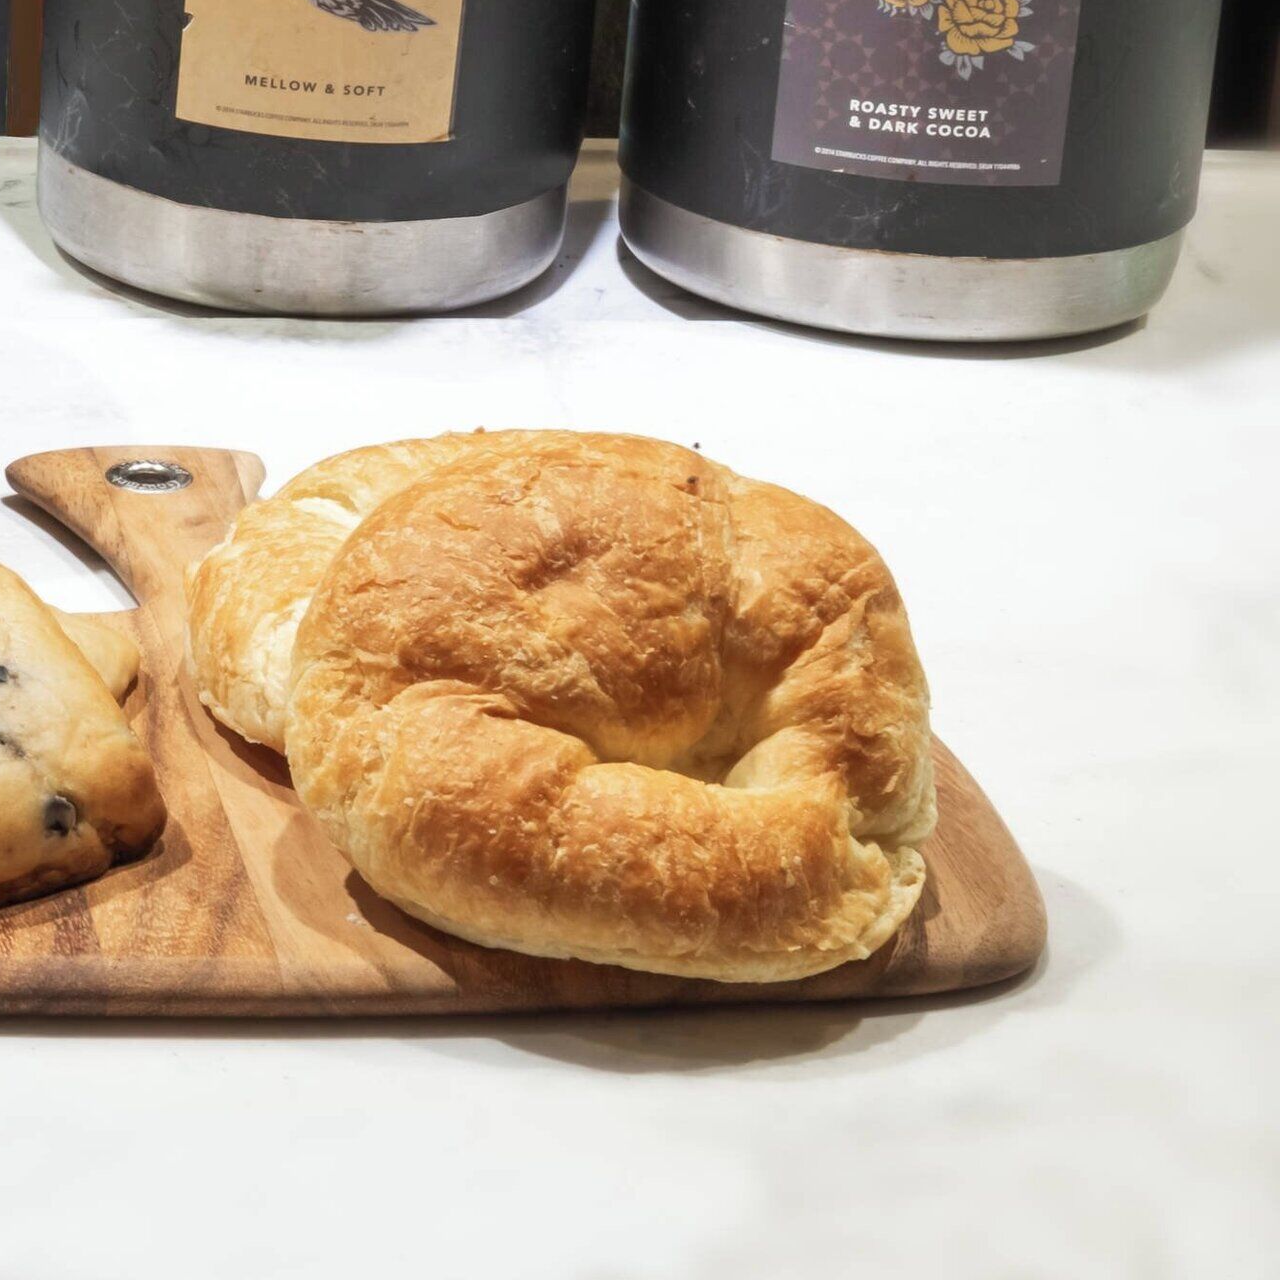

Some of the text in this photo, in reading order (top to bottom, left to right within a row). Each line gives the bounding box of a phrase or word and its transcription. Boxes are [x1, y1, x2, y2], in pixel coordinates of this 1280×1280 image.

[244, 74, 385, 96] MELLOW & SOFT
[849, 99, 989, 122] ROASTY SWEET
[849, 115, 991, 138] & DARK COCOA
